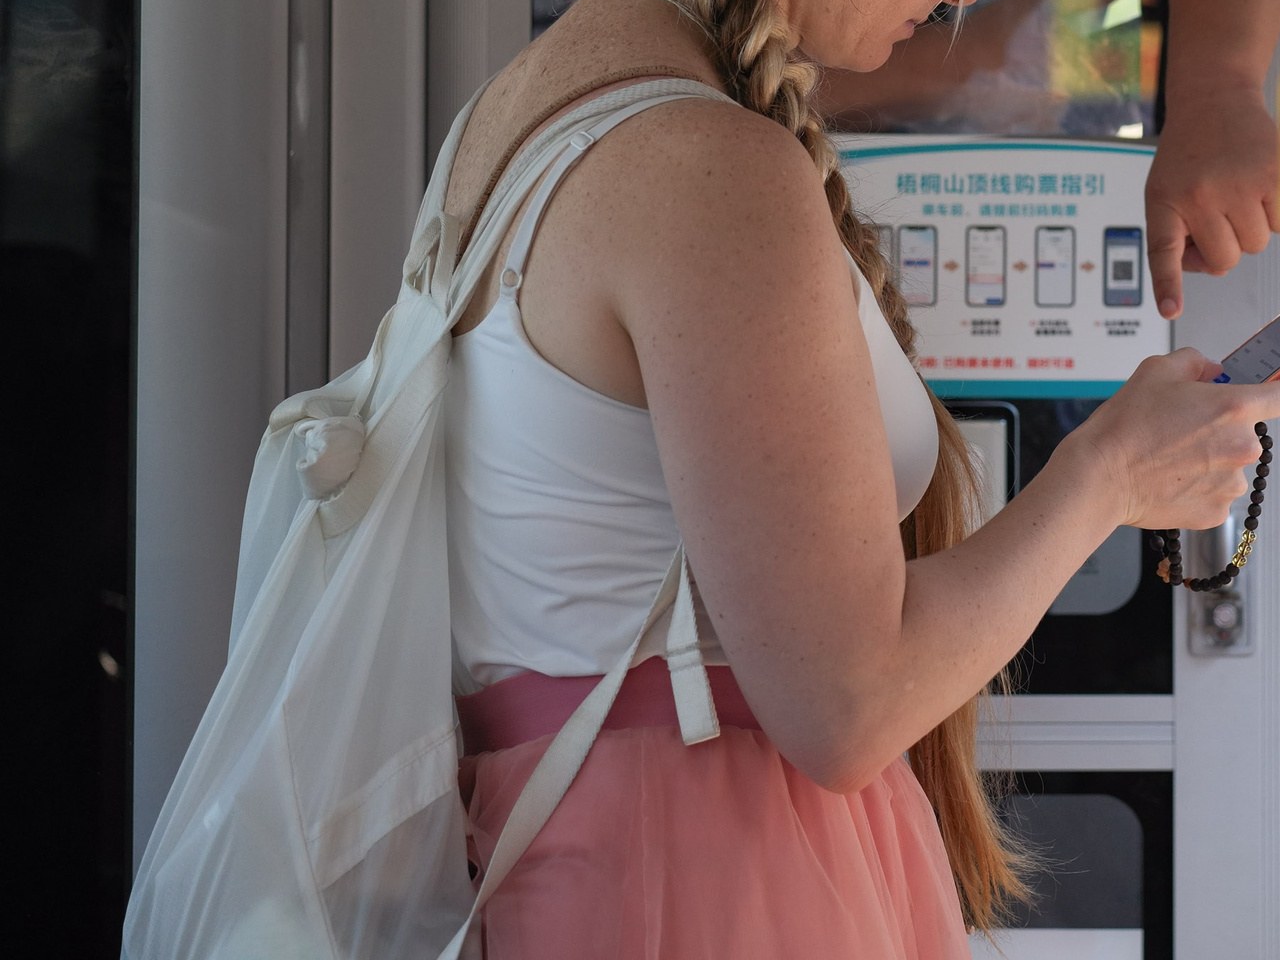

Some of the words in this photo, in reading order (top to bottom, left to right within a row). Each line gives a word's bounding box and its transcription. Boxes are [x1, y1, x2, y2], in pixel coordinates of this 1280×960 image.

[897, 173, 1105, 196] 梧桐山顶线购票指引
